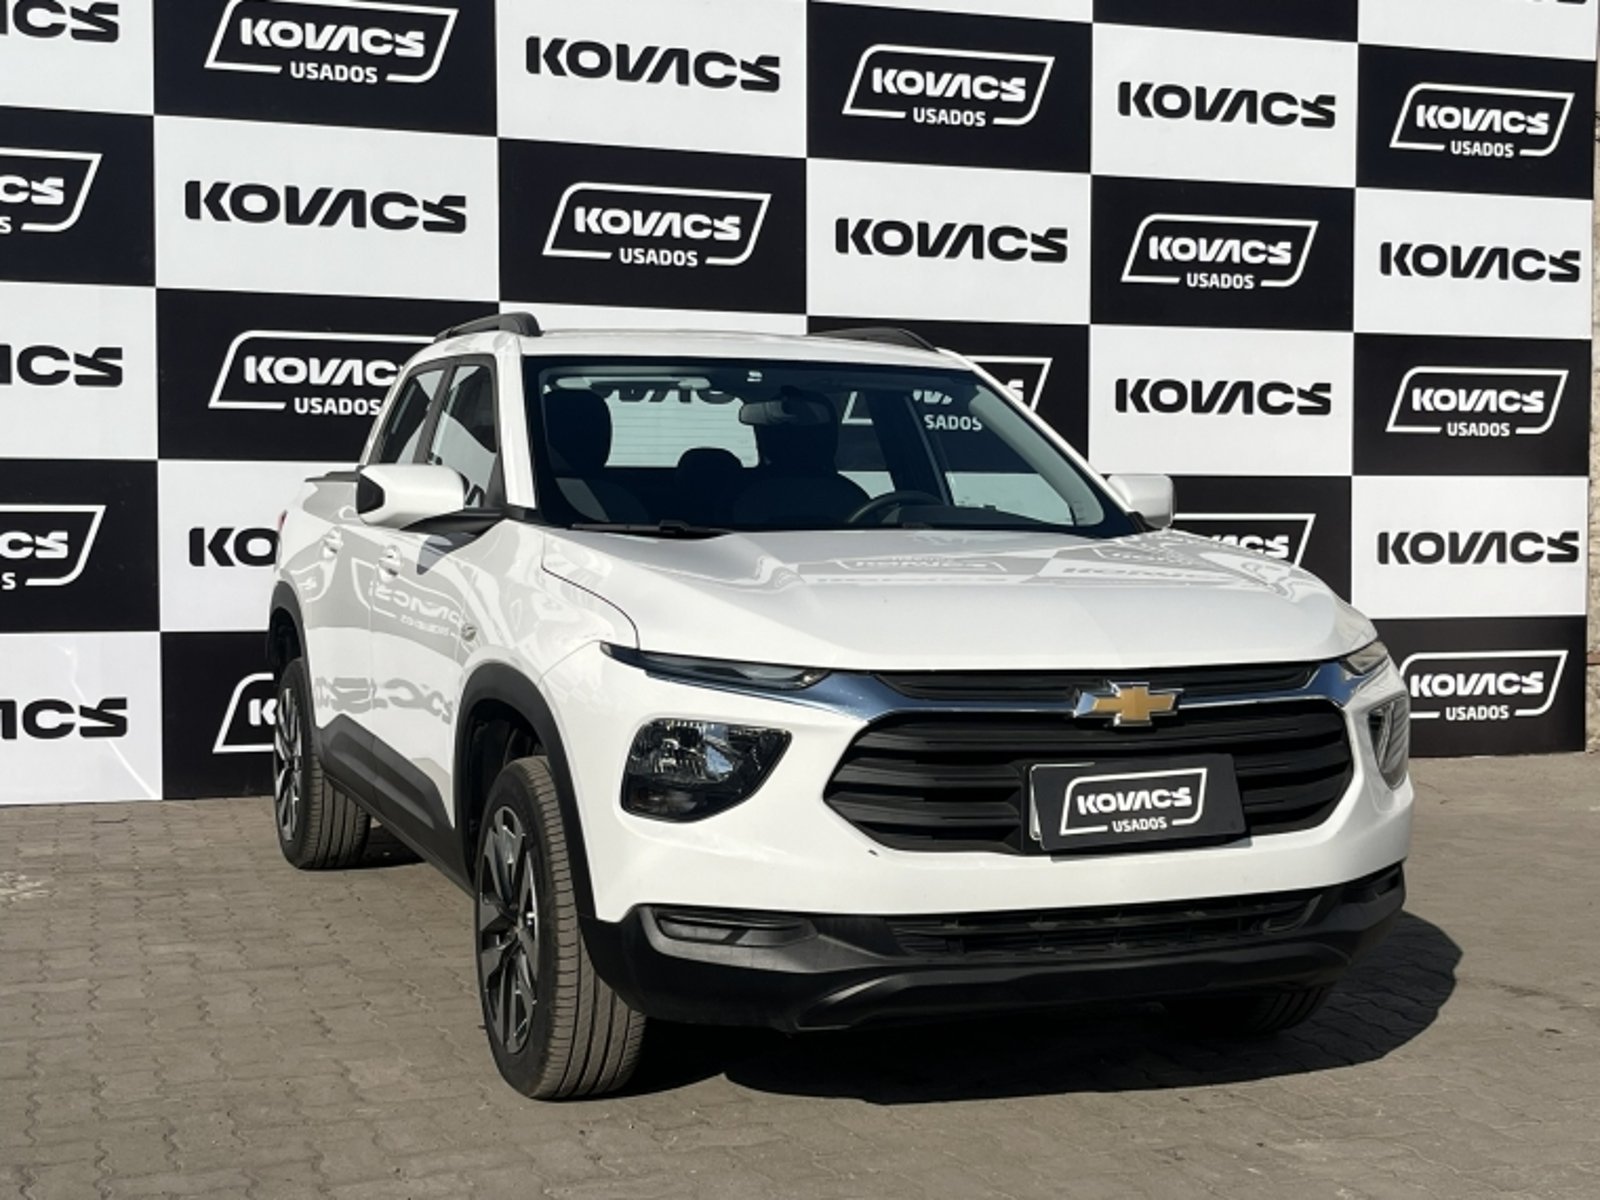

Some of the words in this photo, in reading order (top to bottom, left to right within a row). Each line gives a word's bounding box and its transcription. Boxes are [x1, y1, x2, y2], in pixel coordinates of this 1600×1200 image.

[240, 17, 425, 58] KOVACS
[290, 61, 378, 84] USADOS
[525, 35, 780, 93] KOVACS
[872, 67, 1026, 102] KOVACS
[913, 107, 986, 127] USADOS
[1117, 81, 1336, 129] KOVACS
[1416, 104, 1550, 136] KOVACS
[1450, 140, 1515, 158] USADOS
[184, 180, 467, 234] KOVACS
[574, 206, 741, 241] KOVACS
[835, 217, 1068, 264] KOVACS
[1149, 236, 1292, 265] KOVACS
[619, 247, 698, 267] USADOS
[1380, 241, 1581, 283] KOVACS
[1186, 272, 1255, 290] USADOS
[243, 354, 404, 387] KOVAC
[1115, 378, 1332, 416] KOVACS
[1412, 388, 1544, 413] KOVACS
[923, 413, 983, 432] SADOS
[1447, 421, 1511, 437] USADOS
[1377, 530, 1580, 565] KOVACS
[1410, 671, 1544, 698] KOVACS
[1445, 704, 1510, 721] USADOS
[1076, 786, 1193, 815] KOVACS
[1111, 816, 1168, 833] USADOS
